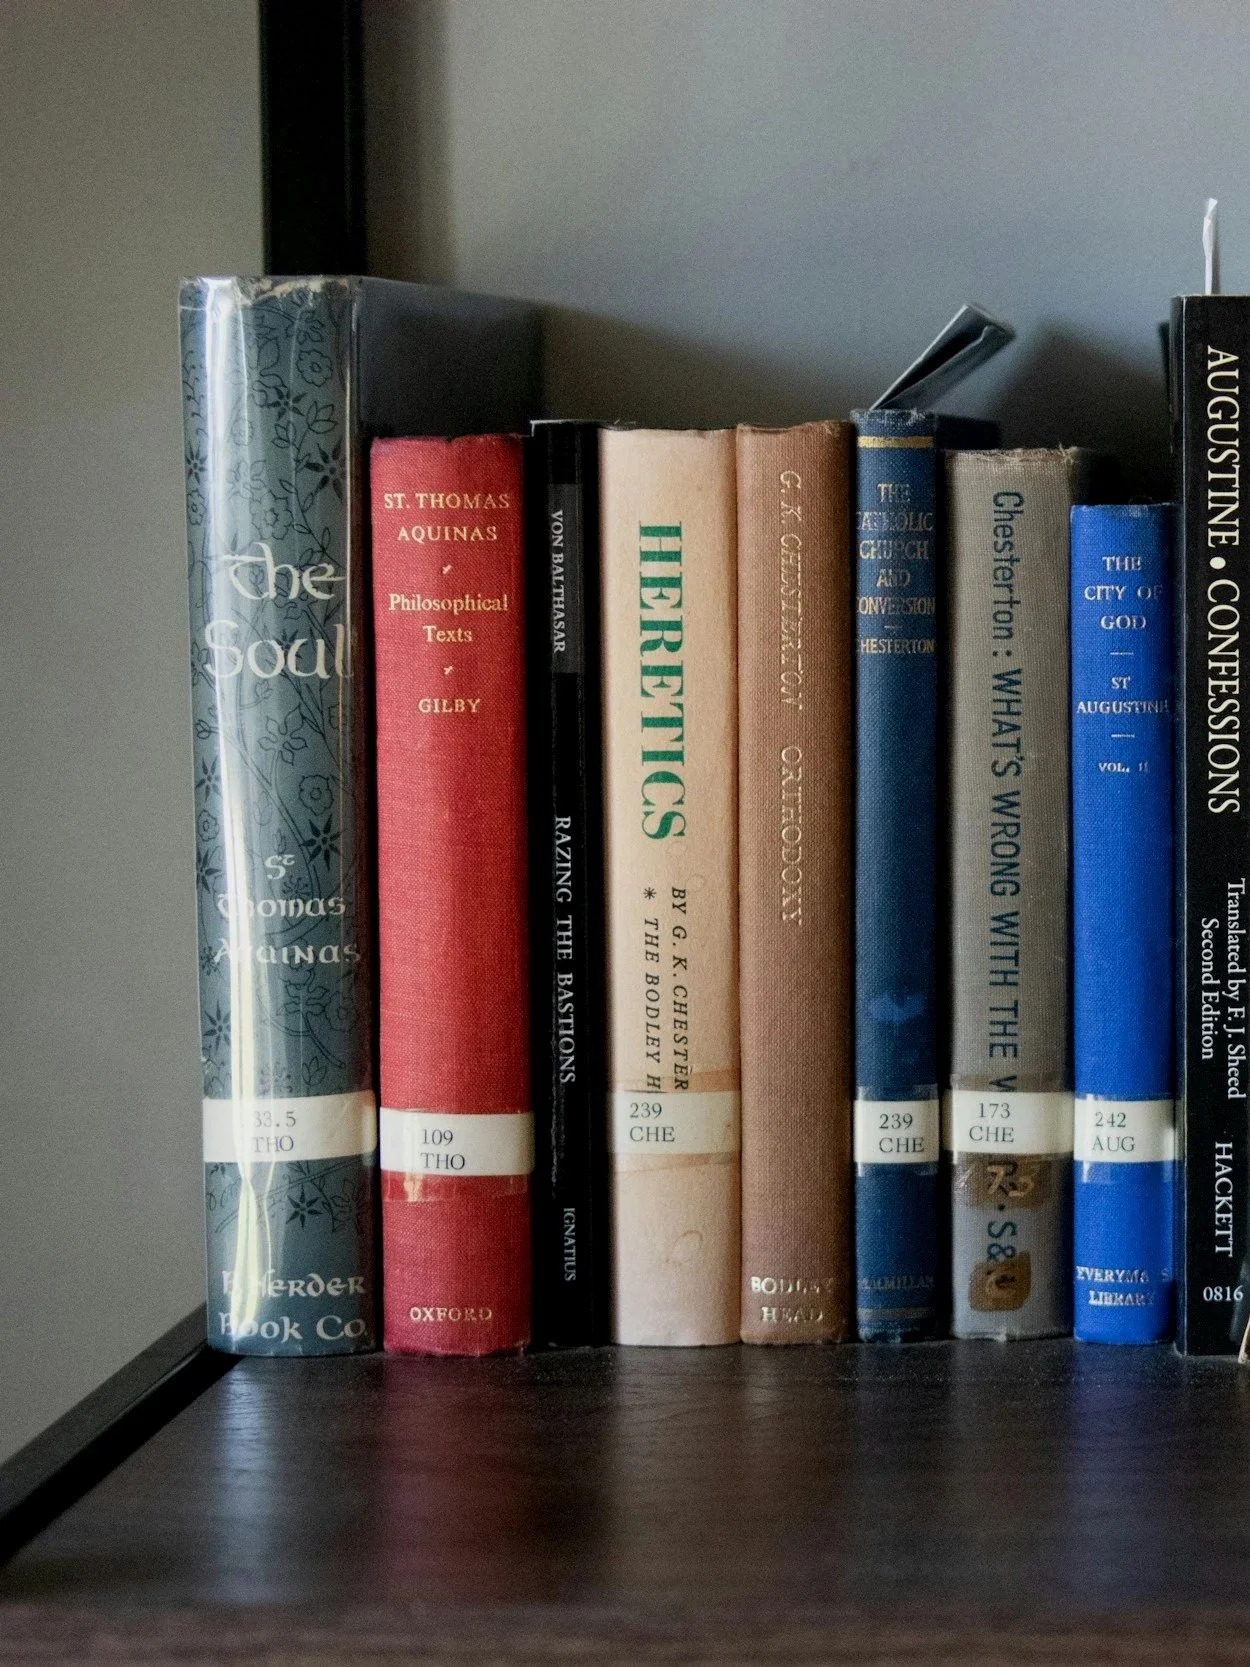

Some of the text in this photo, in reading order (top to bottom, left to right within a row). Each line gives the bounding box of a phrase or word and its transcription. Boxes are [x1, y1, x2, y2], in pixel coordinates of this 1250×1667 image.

[383, 492, 510, 510] ST. THOMAS
[876, 483, 912, 503] THE
[397, 525, 499, 545] AQUINAS
[858, 540, 930, 560] CHURCH
[213, 540, 346, 601] The
[1101, 556, 1142, 572] THE
[550, 509, 567, 654] VON BALTHASAR
[876, 567, 911, 588] AND
[1206, 344, 1241, 816] AUGUSTINE CONFESSIONS
[1084, 585, 1163, 601] CITY OF
[388, 593, 509, 615] Philosophical
[1100, 614, 1147, 630] GOD
[422, 625, 473, 644] Texts
[204, 618, 353, 680] Soul
[637, 520, 688, 842] HERETICS
[1111, 676, 1132, 690] ST
[417, 698, 481, 714] GILBY
[1076, 701, 1170, 715] AUGUSTINE
[990, 667, 1026, 779] WHAT'S
[1098, 762, 1130, 773] VOL.
[989, 792, 1021, 898] WRONG
[671, 886, 687, 915] BY
[554, 815, 577, 1085] RAZING THE BASTIONS
[989, 910, 1020, 987] WITH
[643, 917, 661, 1065] THE BODLEY
[1201, 917, 1221, 1061] Second Edition
[1221, 877, 1248, 1100] Translated by F. J. Sheed
[988, 1000, 1019, 1059] THE
[629, 1102, 663, 1120] 239
[978, 1103, 1011, 1119] 173
[1095, 1111, 1127, 1129] 242
[879, 1112, 914, 1130] 239
[251, 1134, 295, 1153] THO
[420, 1128, 454, 1147] 109
[628, 1125, 676, 1144] CHE
[969, 1126, 1016, 1144] CHE
[1092, 1135, 1137, 1153] AUG
[878, 1136, 925, 1154] CHE
[419, 1152, 466, 1171] THO
[1214, 1140, 1234, 1259] HACKETT
[563, 1206, 577, 1283] IGNATIUS
[1202, 1285, 1244, 1302] 0816
[409, 1306, 493, 1323] OXFORD
